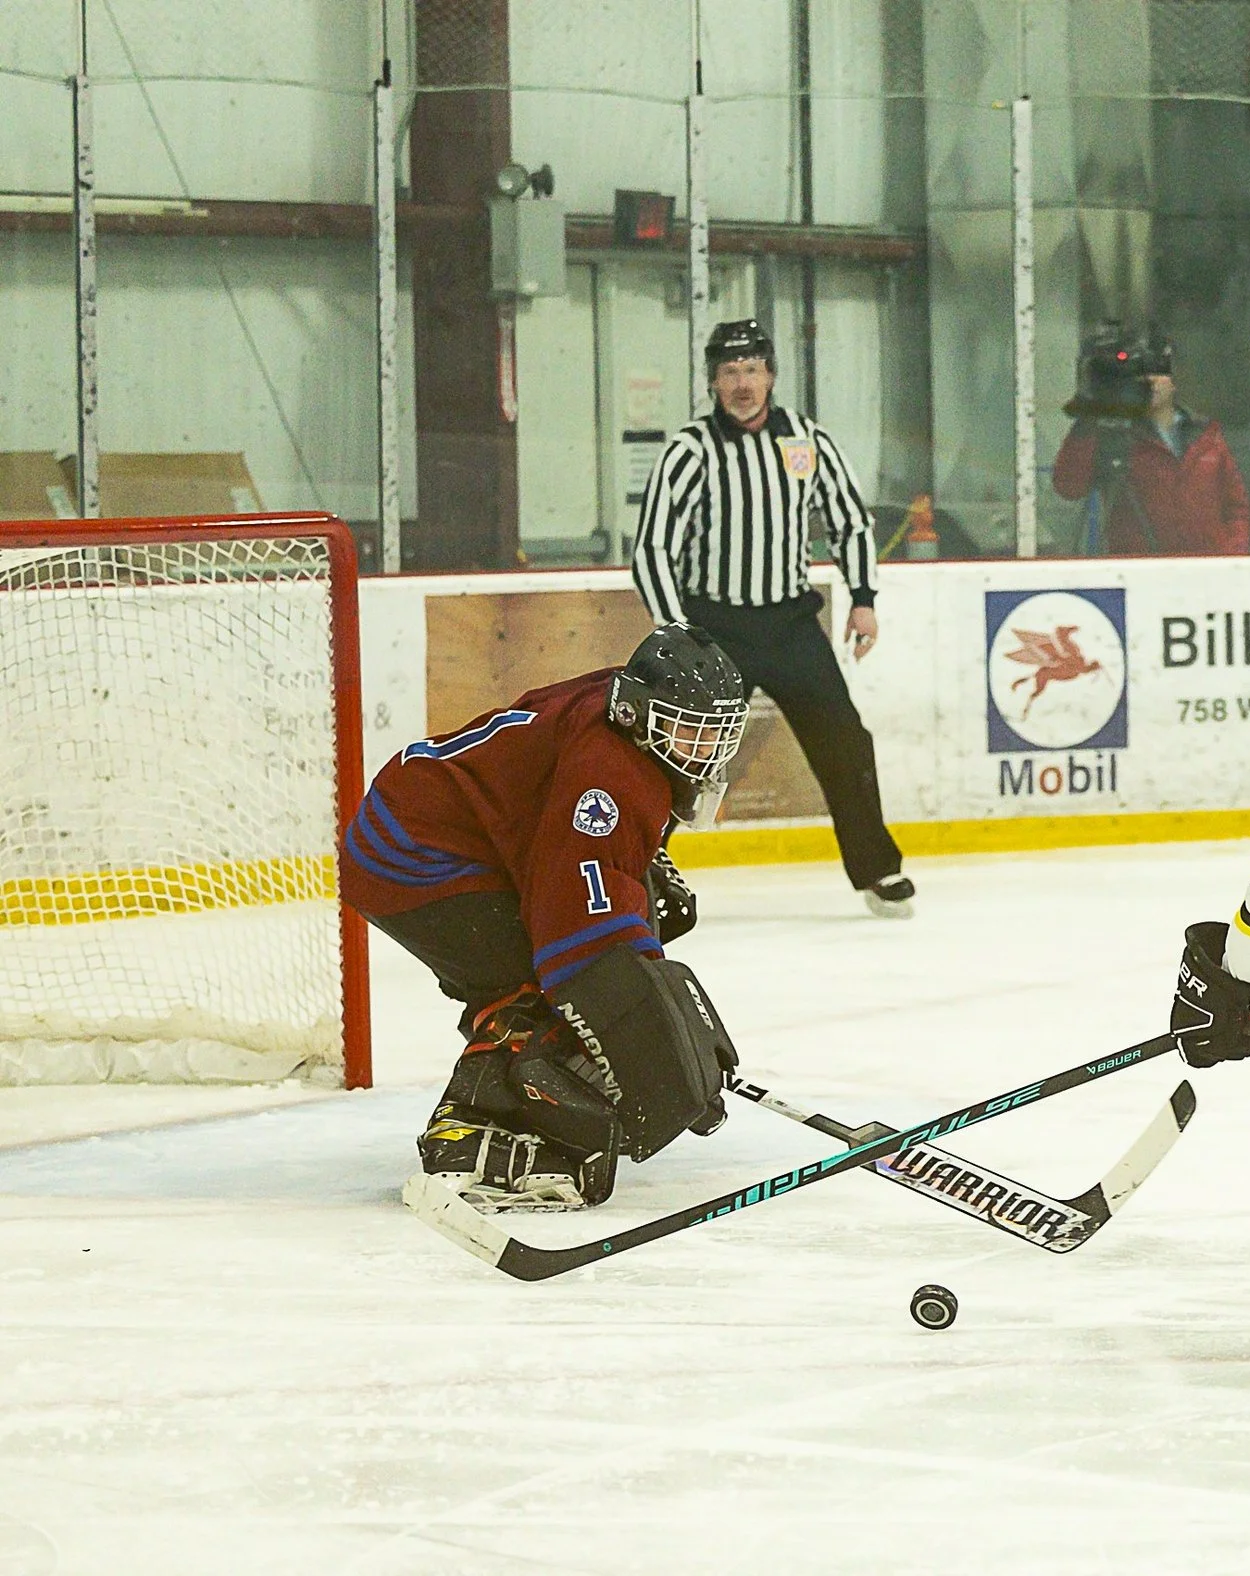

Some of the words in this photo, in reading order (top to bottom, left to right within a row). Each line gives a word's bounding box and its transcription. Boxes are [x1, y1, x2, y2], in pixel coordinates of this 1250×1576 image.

[1177, 699, 1228, 722] 758
[998, 753, 1118, 796] Mobil
[579, 859, 612, 915] 1
[900, 1079, 1046, 1151] PULSE
[888, 1147, 1070, 1244] WARRIOR
